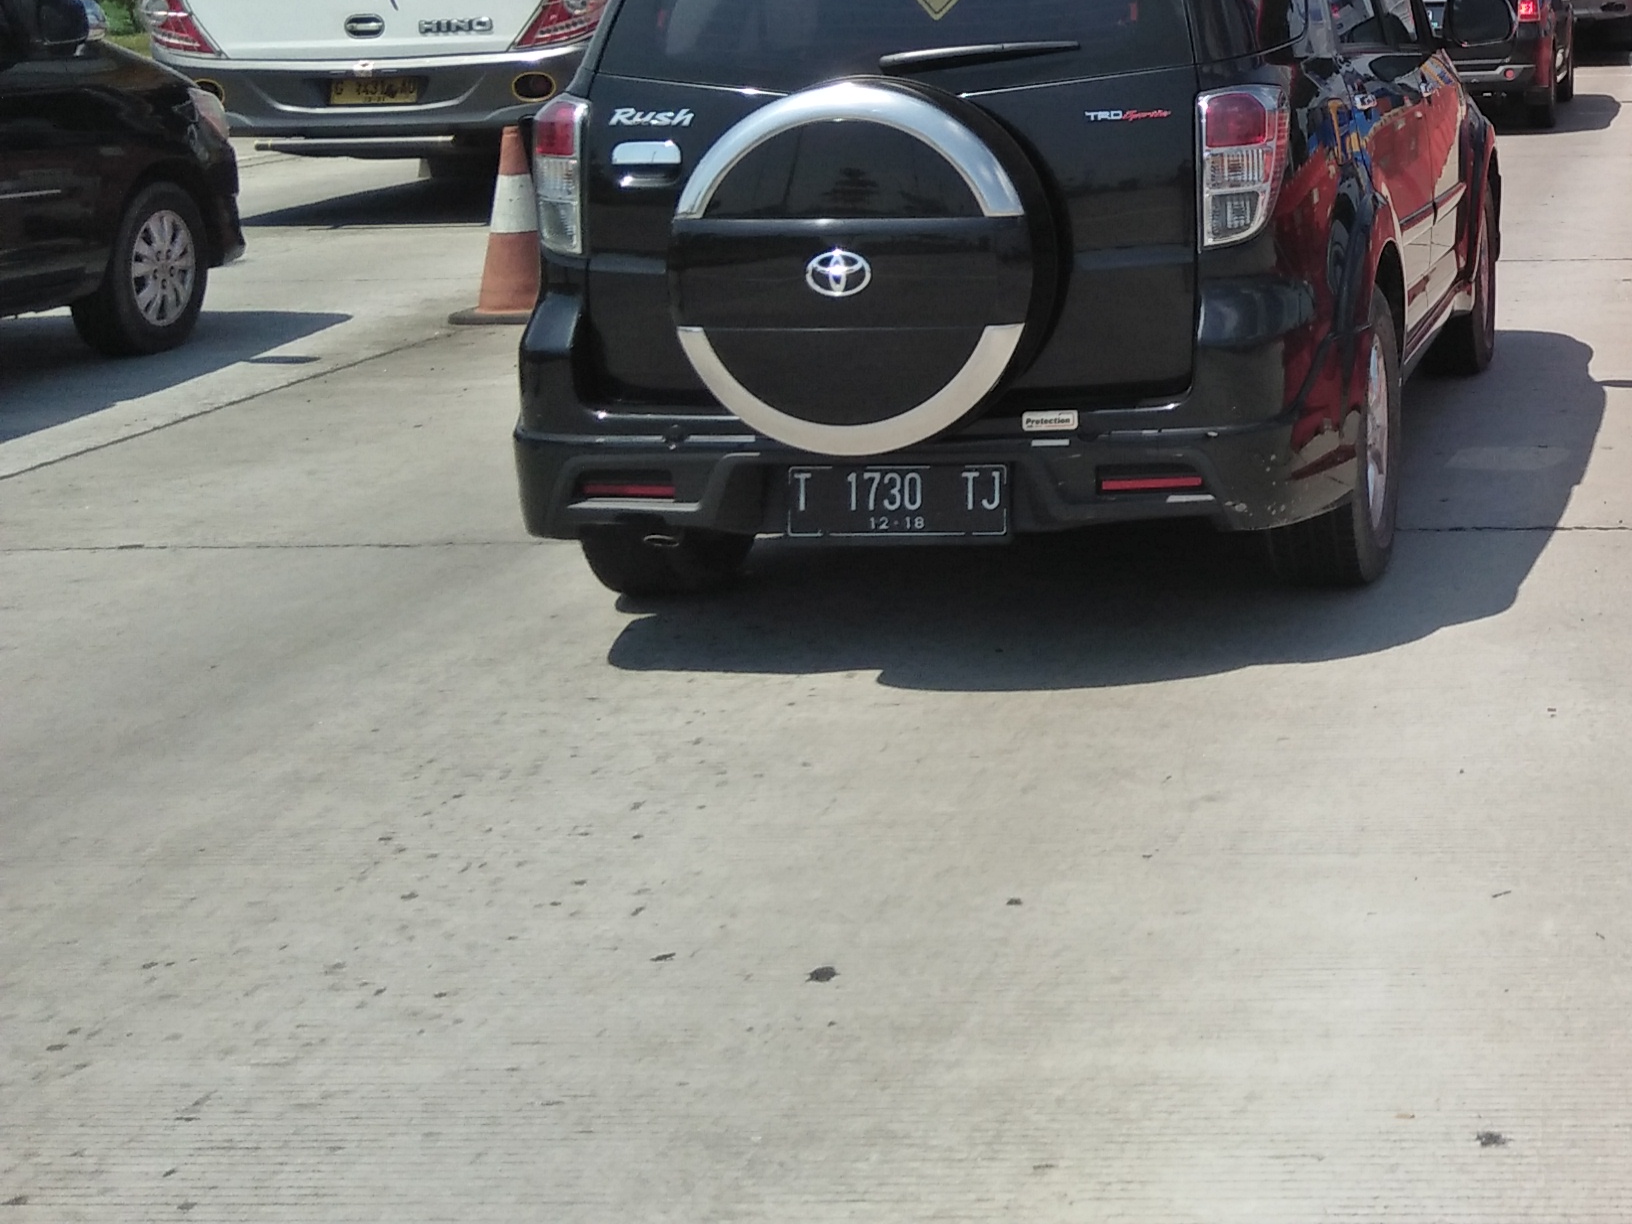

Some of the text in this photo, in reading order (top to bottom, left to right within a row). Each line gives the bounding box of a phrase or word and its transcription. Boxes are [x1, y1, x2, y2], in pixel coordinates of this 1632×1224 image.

[418, 16, 494, 34] HINO
[608, 107, 695, 127] Rush
[1084, 110, 1123, 121] TRD
[1025, 416, 1071, 425] Protection
[794, 471, 1001, 511] T 1730 TJ
